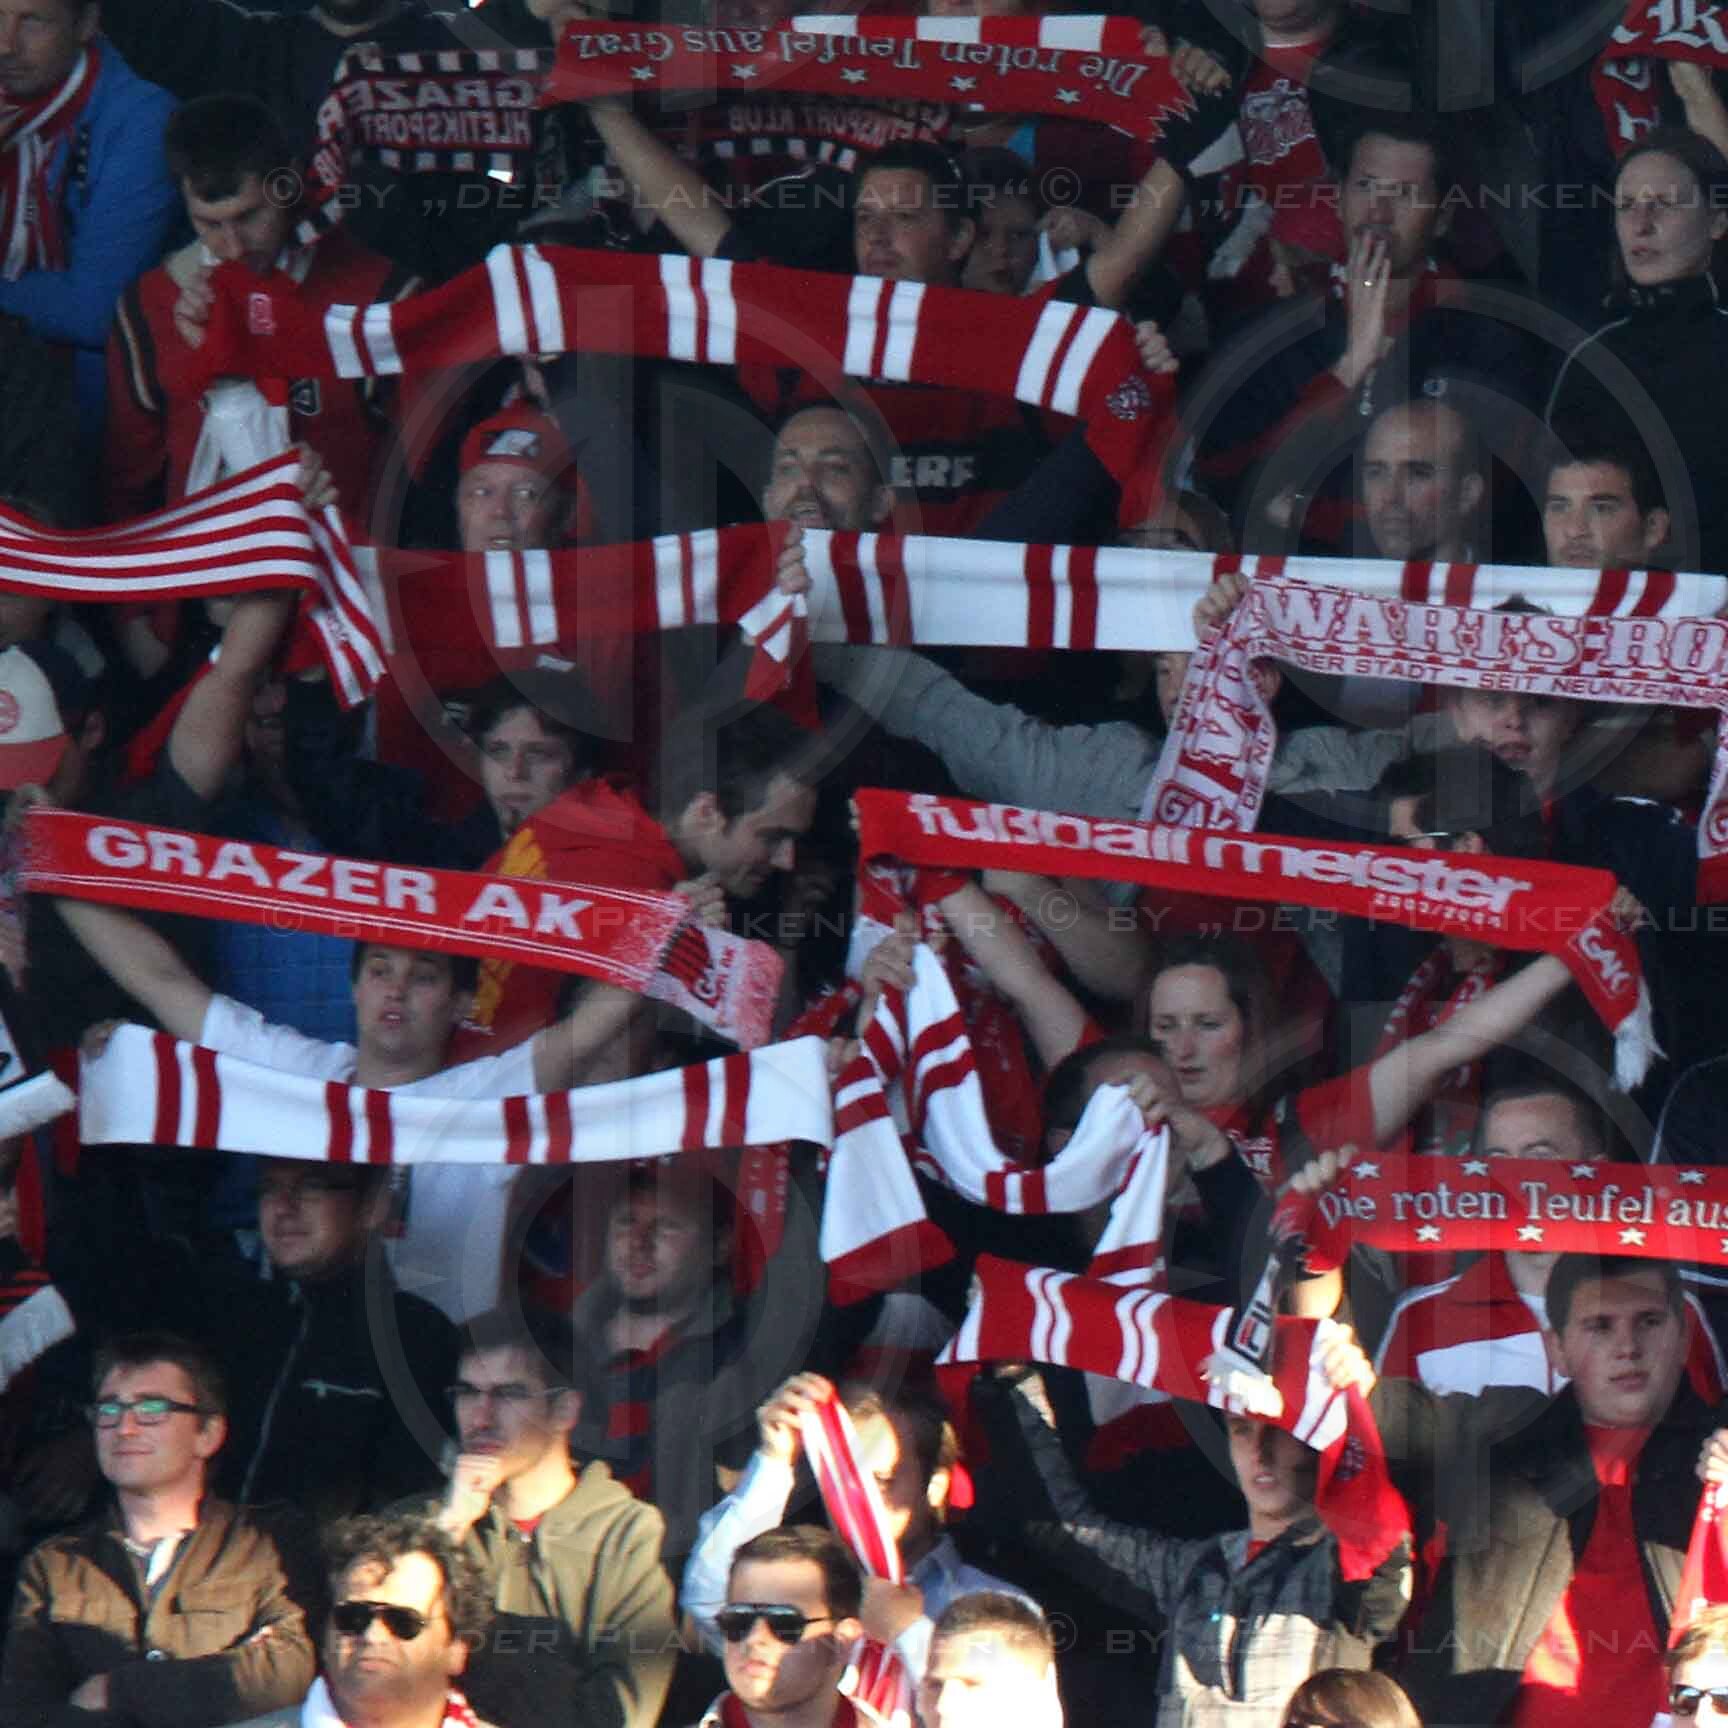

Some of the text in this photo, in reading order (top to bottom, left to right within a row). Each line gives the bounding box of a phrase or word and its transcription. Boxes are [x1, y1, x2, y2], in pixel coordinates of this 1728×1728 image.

[86, 823, 595, 941] GRAZER AK
[907, 794, 1534, 915] fußball meister
[1318, 1190, 1377, 1230] Die
[1392, 1181, 1508, 1221] roten
[1519, 1180, 1655, 1225] Teufel
